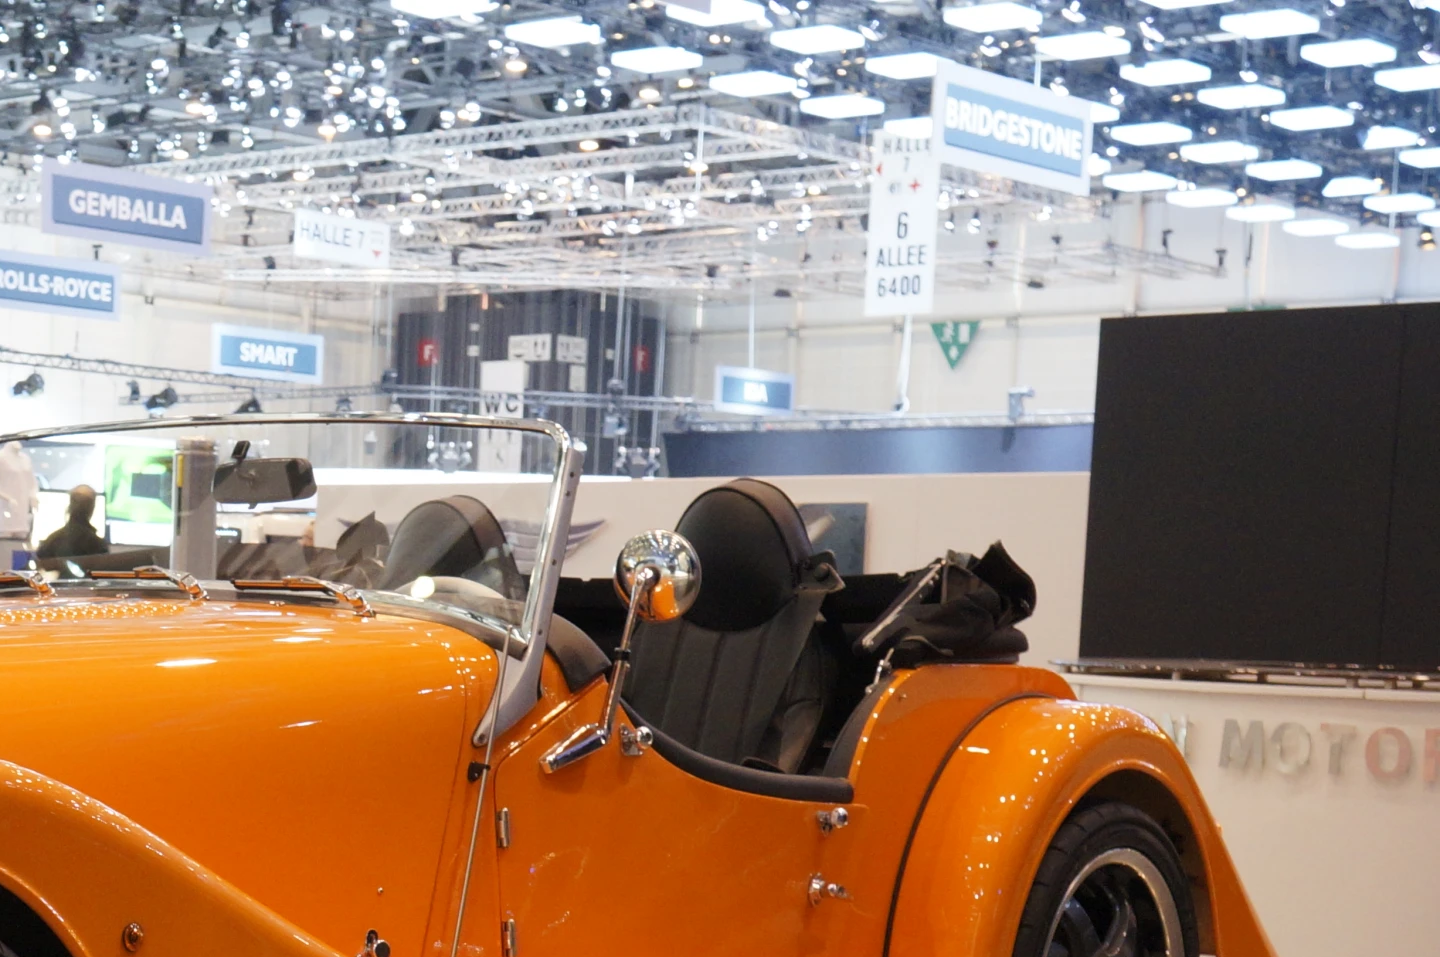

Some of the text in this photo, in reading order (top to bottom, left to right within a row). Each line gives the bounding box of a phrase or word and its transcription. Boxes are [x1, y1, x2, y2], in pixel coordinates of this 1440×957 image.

[945, 96, 1082, 161] BRIDGESTONE
[69, 189, 188, 230] GEMBALLA
[299, 219, 351, 248] HALLE
[897, 211, 909, 240] 6
[876, 244, 927, 268] ALLEE
[877, 274, 921, 298] 6400
[240, 341, 298, 367] SMART
[484, 391, 519, 414] WC
